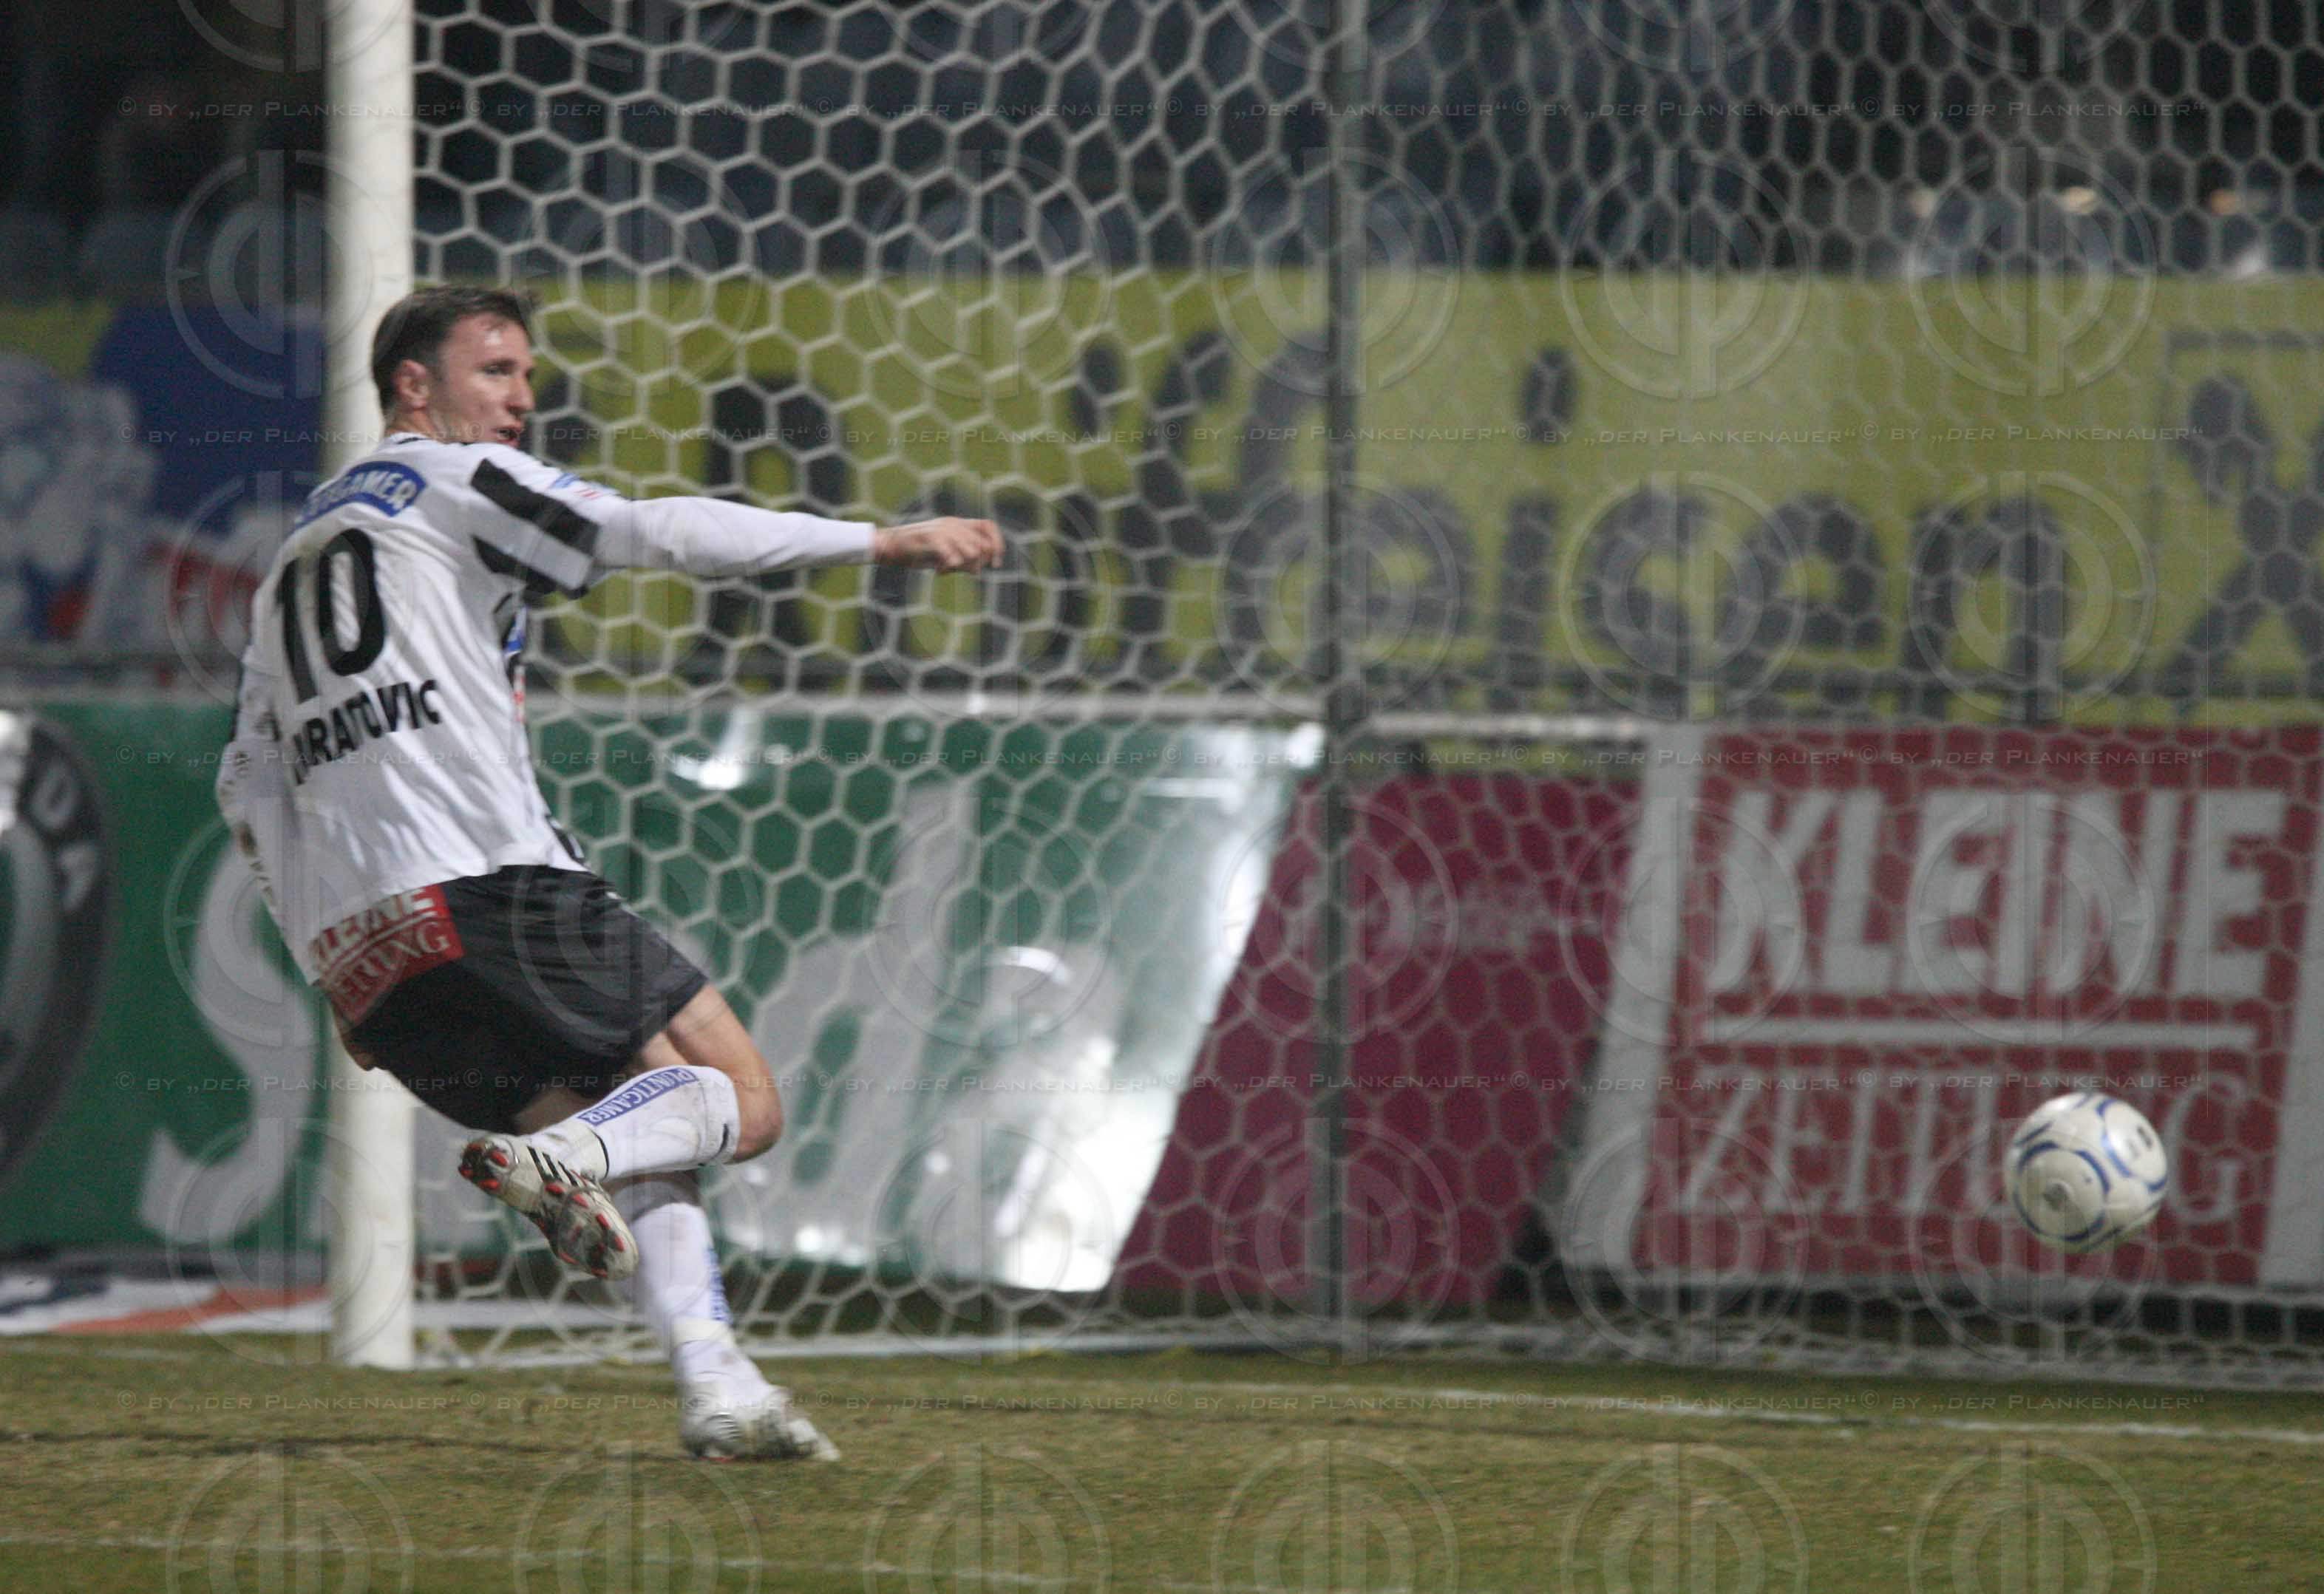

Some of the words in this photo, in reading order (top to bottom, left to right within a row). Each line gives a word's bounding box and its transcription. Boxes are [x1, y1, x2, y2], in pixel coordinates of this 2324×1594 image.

[276, 528, 386, 704] 10
[1705, 789, 2289, 996] KLEINE
[581, 1068, 693, 1123] PUNTIGAMER
[1675, 1066, 2247, 1224] ZEITUG
